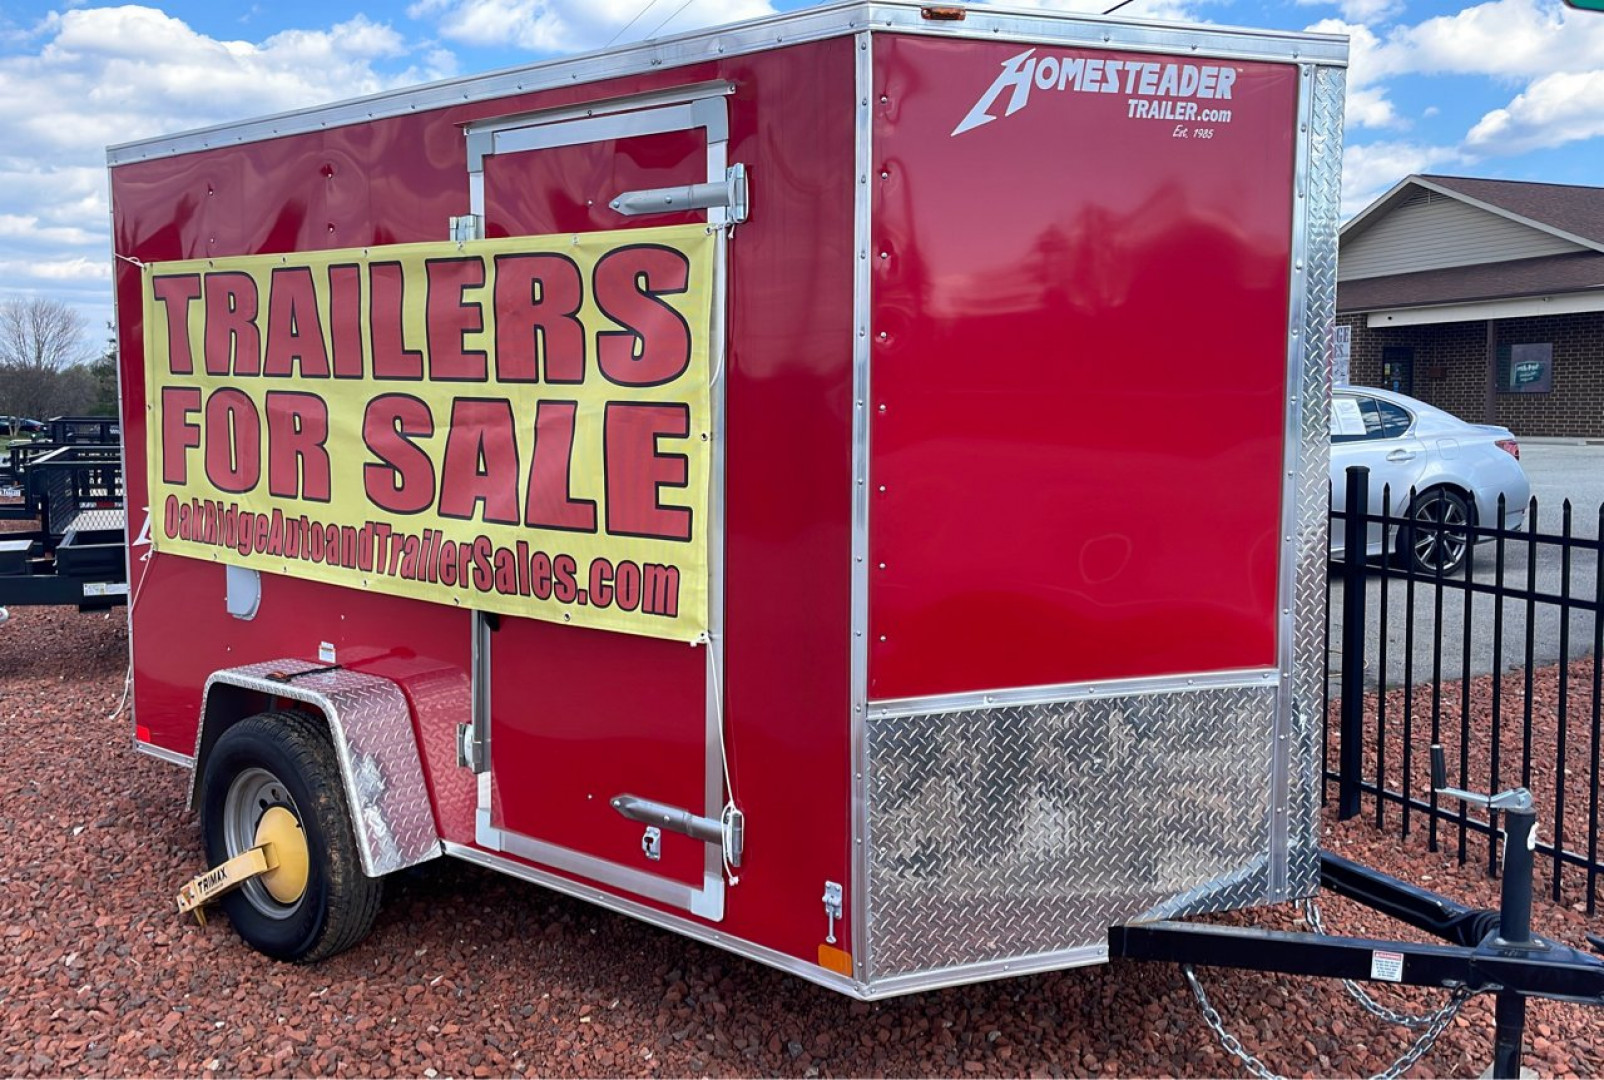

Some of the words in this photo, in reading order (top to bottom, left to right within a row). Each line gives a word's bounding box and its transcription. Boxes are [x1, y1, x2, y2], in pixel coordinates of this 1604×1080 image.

[1128, 98, 1232, 122] TRAILER.com
[1193, 128, 1214, 139] 1985
[152, 243, 692, 388] TRAILERS
[161, 386, 331, 503] FOR
[362, 392, 693, 542] SALE
[164, 494, 680, 618] OakRidgeAutoandTrailerSales.com
[197, 866, 228, 894] TRIMAX
